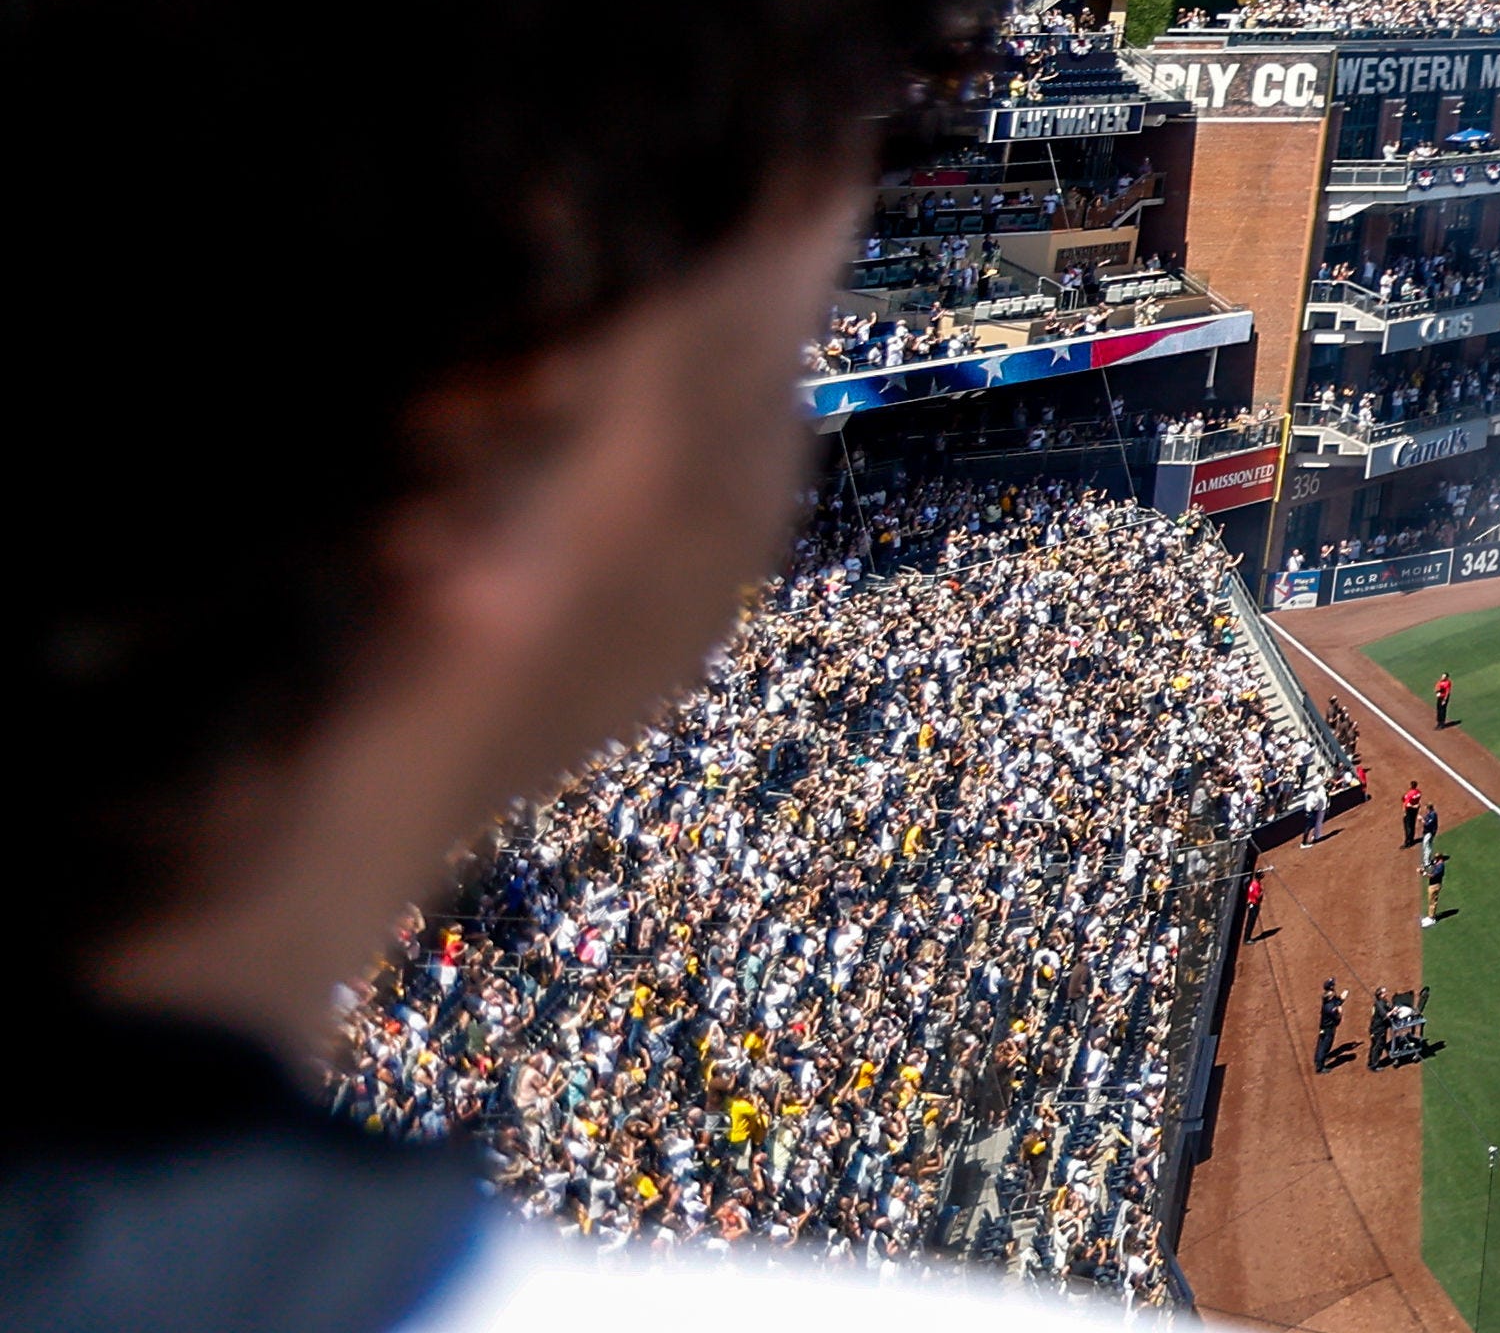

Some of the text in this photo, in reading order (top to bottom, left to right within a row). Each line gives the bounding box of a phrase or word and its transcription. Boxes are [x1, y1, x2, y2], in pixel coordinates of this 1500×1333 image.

[1250, 62, 1326, 109] CO.
[1336, 55, 1471, 96] WESTERN
[1393, 427, 1468, 468] Canel's
[1208, 463, 1275, 491] MISSION FED
[1291, 471, 1320, 501] 336
[1461, 548, 1499, 577] 342
